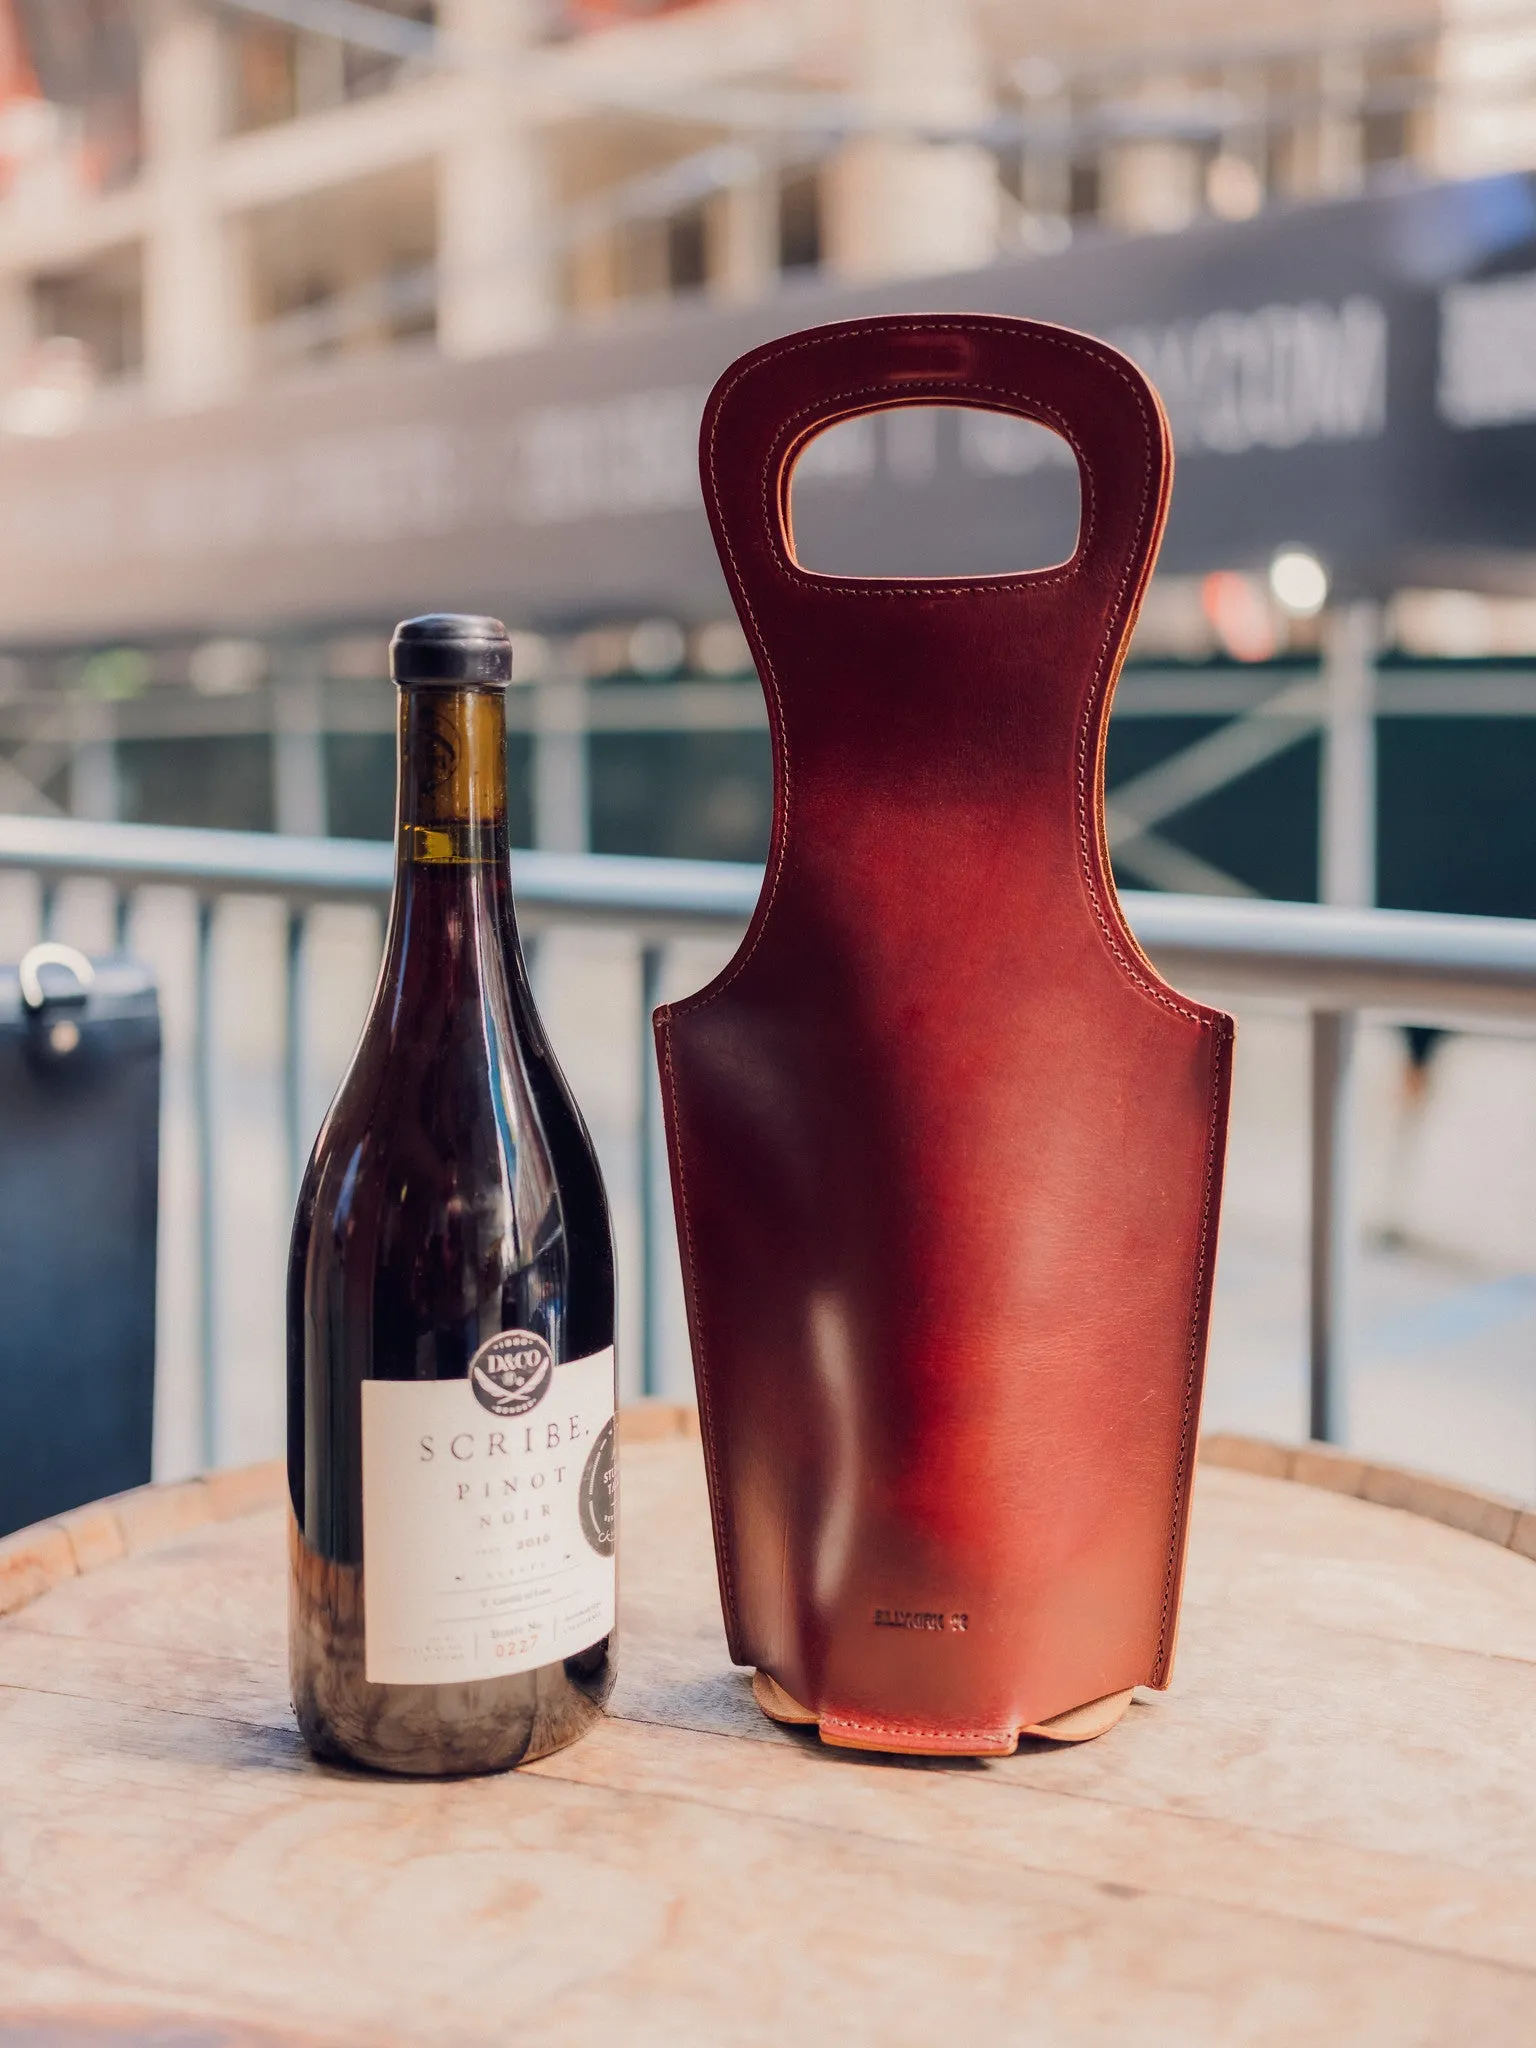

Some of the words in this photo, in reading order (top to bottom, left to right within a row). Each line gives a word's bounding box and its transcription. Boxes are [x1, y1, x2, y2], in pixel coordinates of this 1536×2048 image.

[458, 1466, 566, 1500] PINOT
[480, 1504, 552, 1529] NOIR
[496, 1634, 538, 1658] 0227
